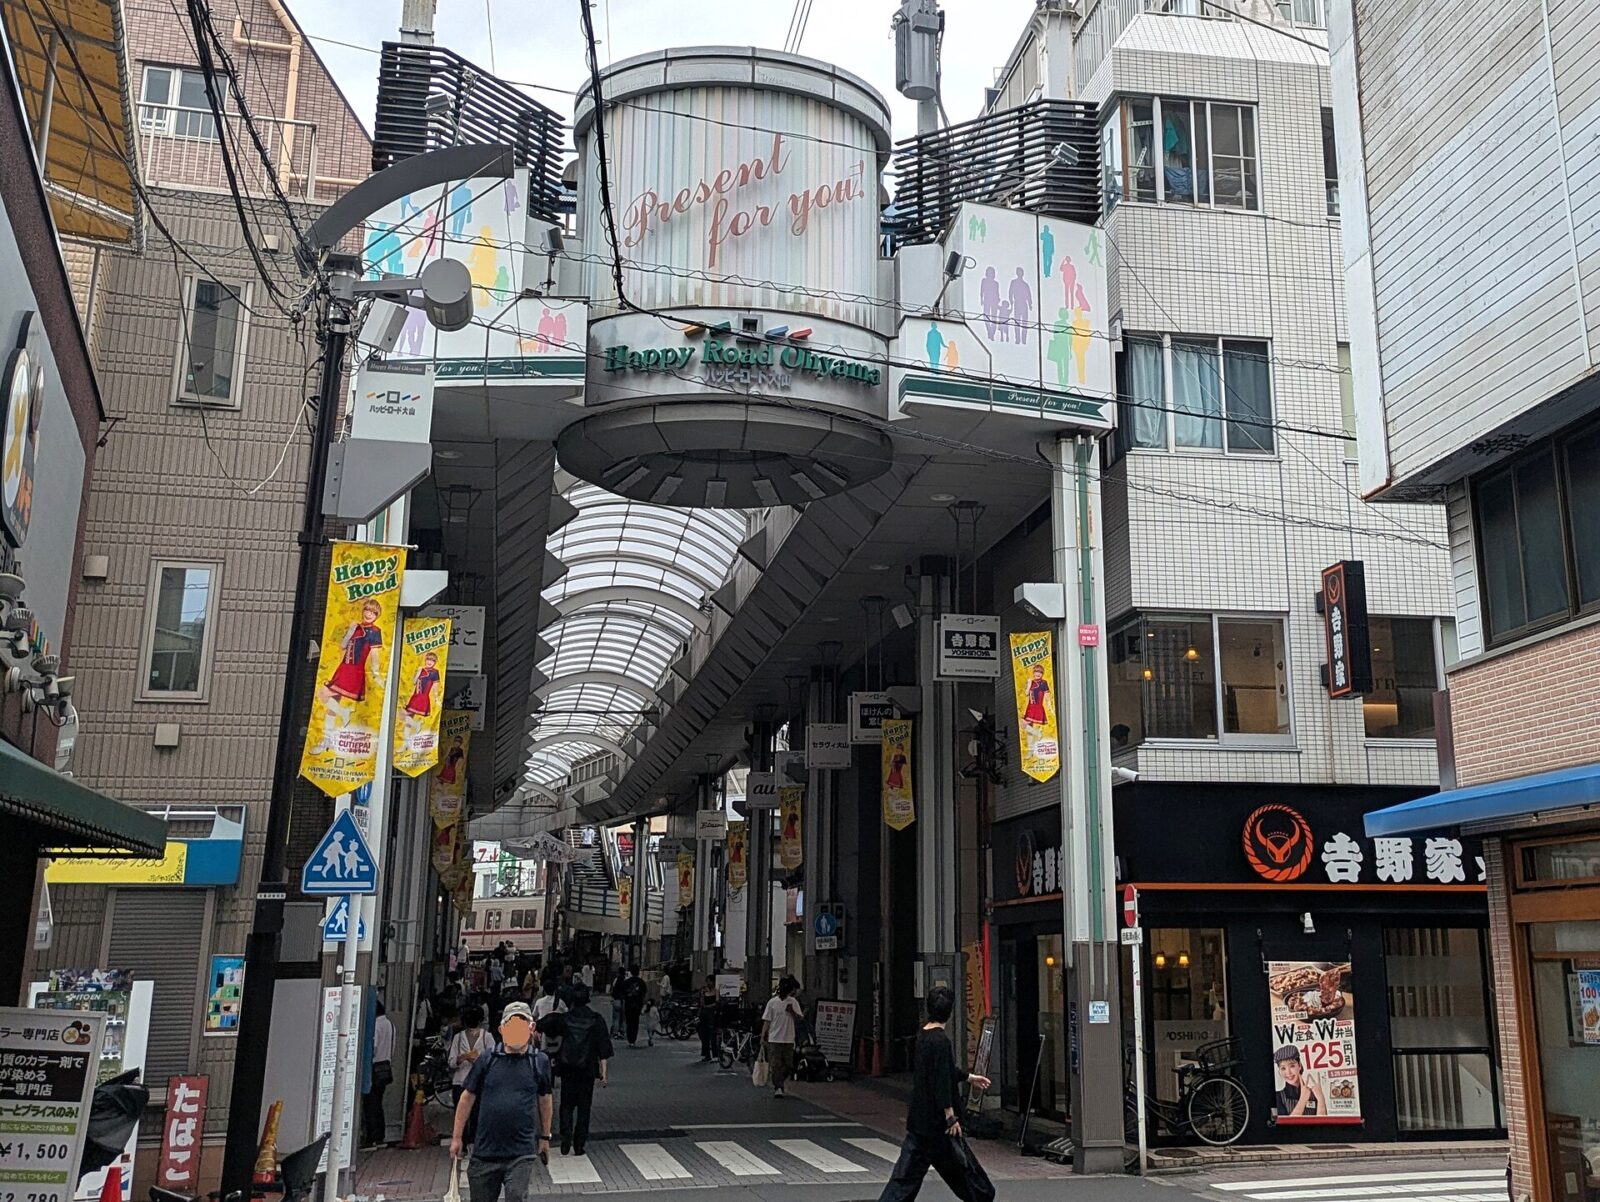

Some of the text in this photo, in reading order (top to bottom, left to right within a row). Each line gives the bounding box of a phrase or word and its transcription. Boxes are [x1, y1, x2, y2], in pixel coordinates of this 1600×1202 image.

[622, 133, 791, 249] Present
[708, 159, 865, 268] for you!
[436, 363, 483, 375] for you!
[603, 339, 881, 386] Happy Road Ohyama
[703, 369, 792, 388] ハッピーロード大山
[369, 405, 416, 416] ハッピーロード大山
[1007, 391, 1082, 411] Present for you!
[334, 555, 398, 582] Happy
[347, 573, 397, 601] Road
[405, 622, 446, 644] Happy
[951, 632, 991, 649] 吉野家
[414, 635, 446, 654] Road
[1012, 636, 1049, 658] Happy
[1021, 648, 1050, 667] Road
[440, 714, 469, 727] Happy
[883, 723, 909, 737] Happy
[446, 724, 470, 737] Road
[889, 732, 910, 744] Road
[752, 782, 776, 795] au
[1321, 832, 1466, 883] 吉野家
[0, 1053, 85, 1069] 質のカラー剤で
[1300, 1041, 1344, 1070] 125
[165, 1083, 201, 1181] たばこ
